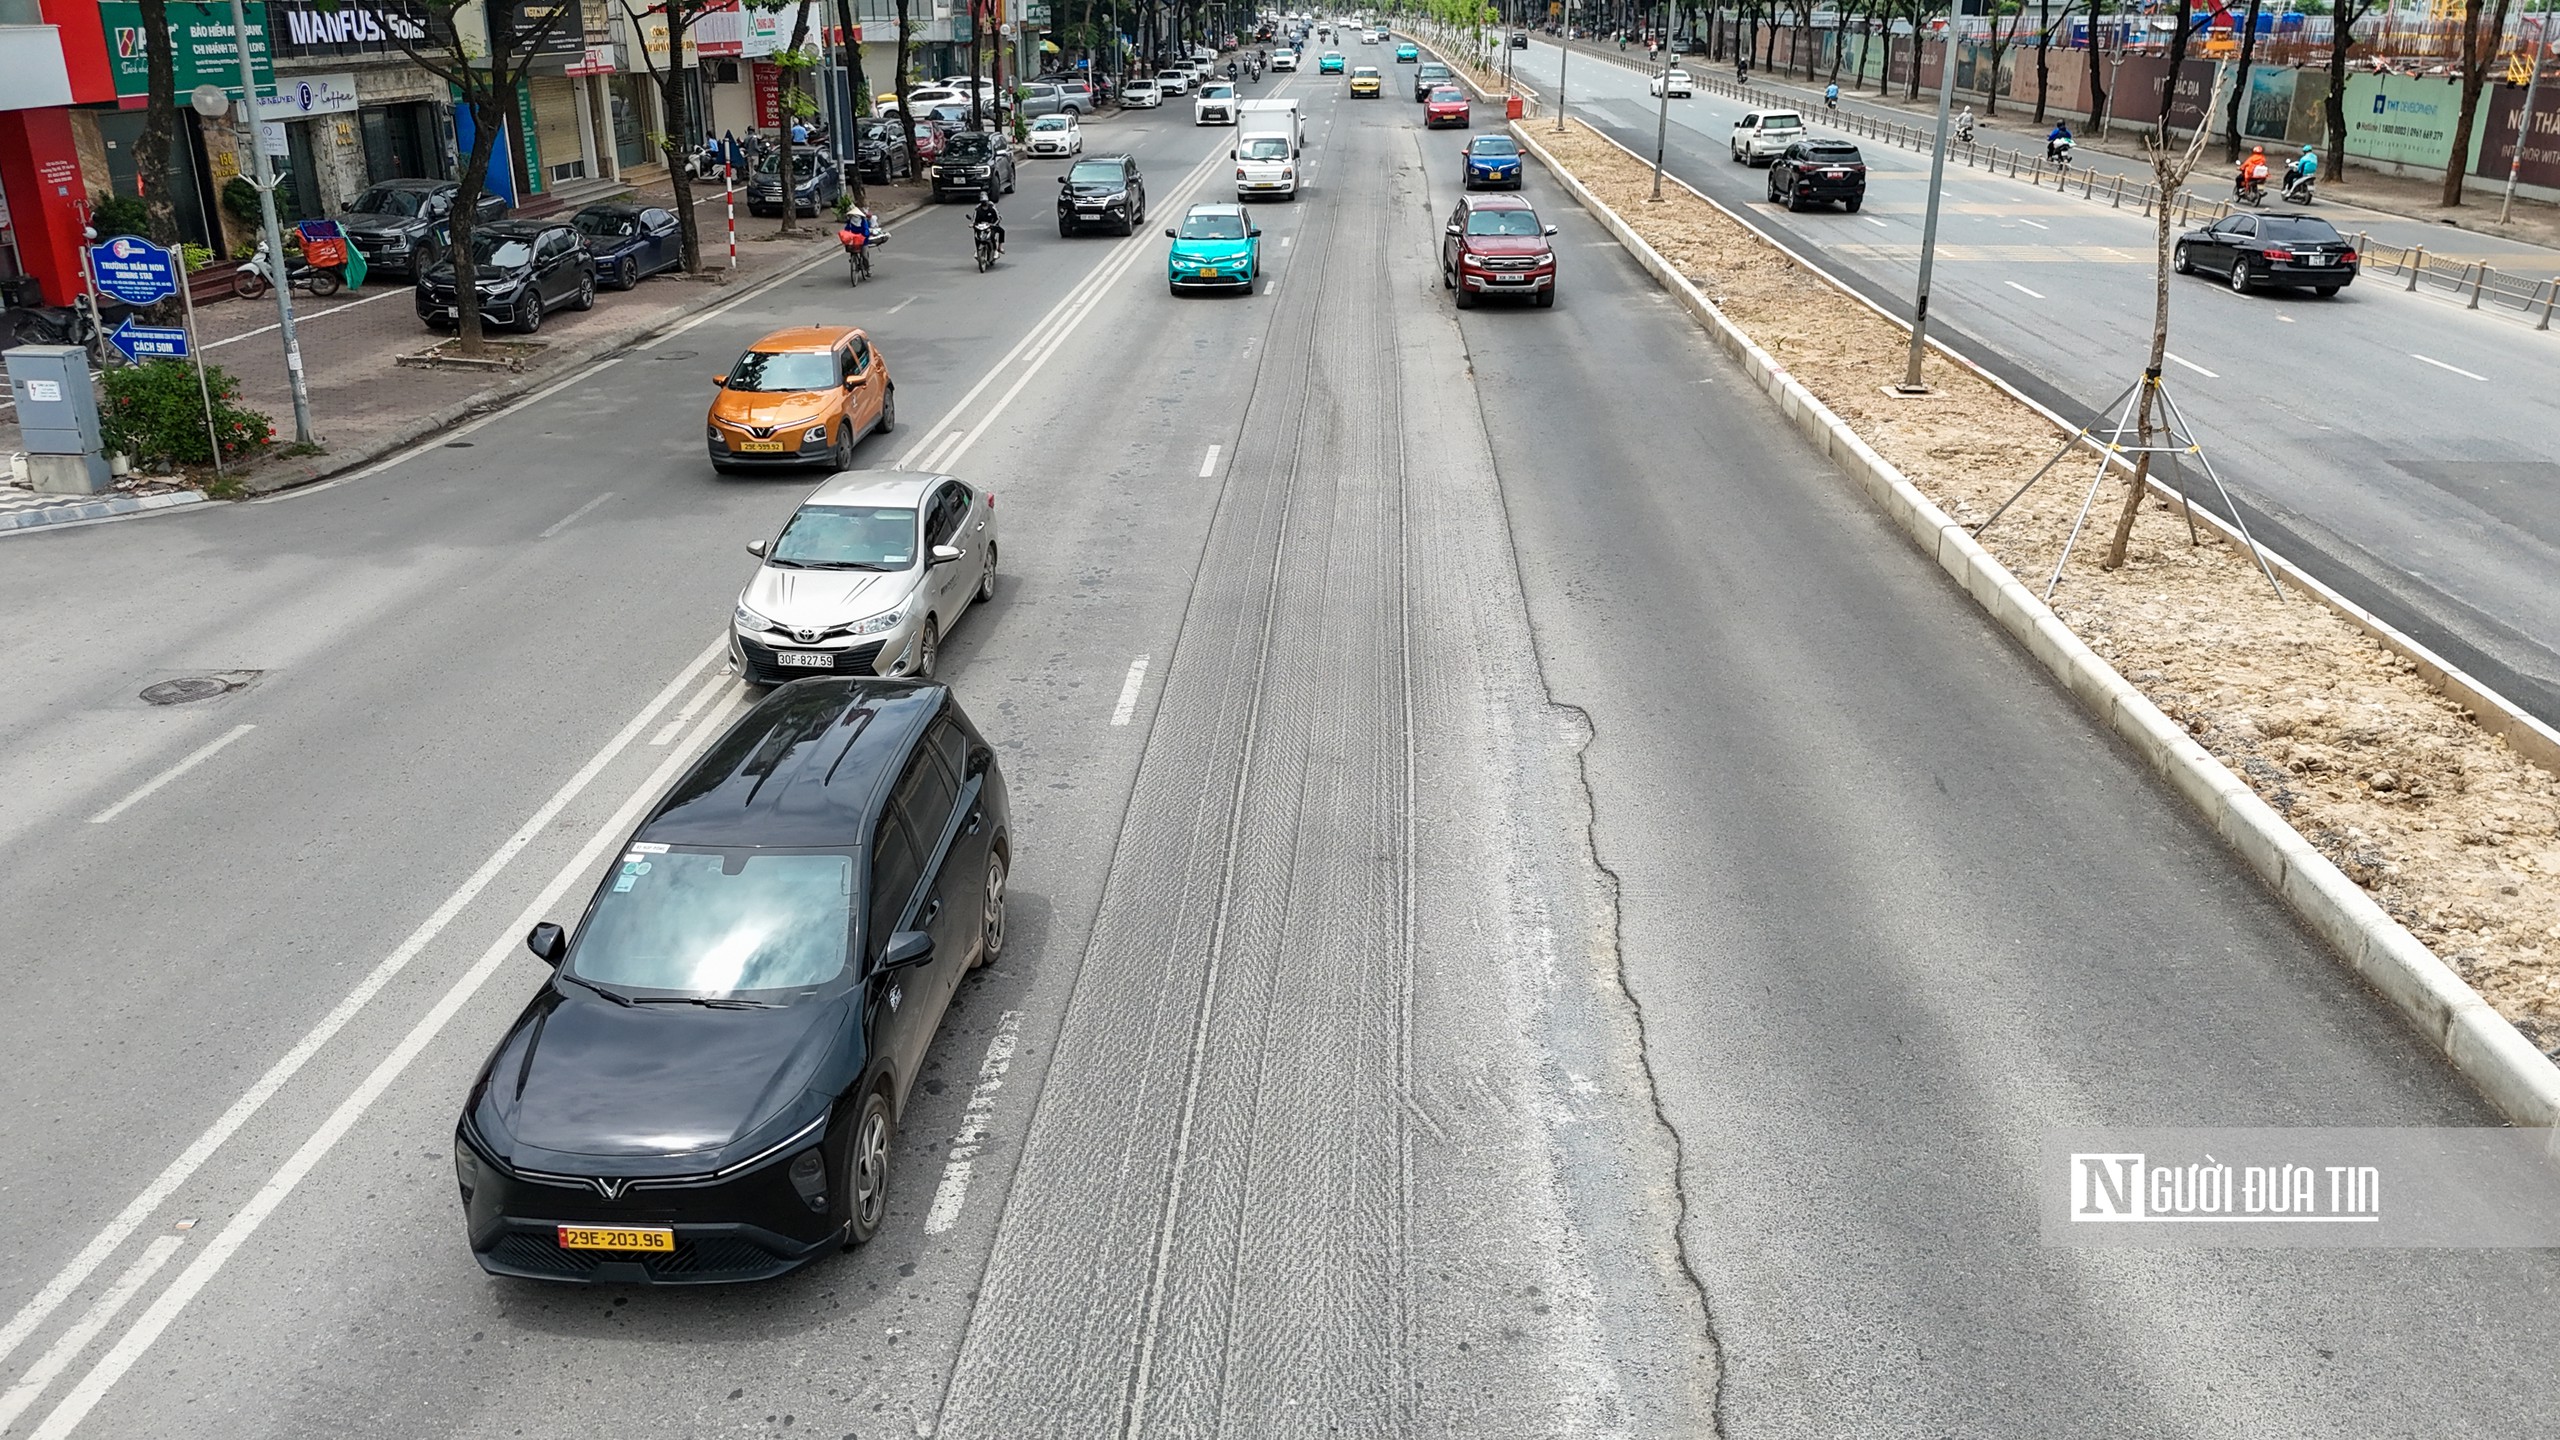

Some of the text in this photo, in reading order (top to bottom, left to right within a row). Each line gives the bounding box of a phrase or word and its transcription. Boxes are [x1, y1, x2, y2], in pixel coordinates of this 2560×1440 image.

[2501, 145, 2541, 161] INTRIOR
[133, 340, 174, 353] CÁCH 50M
[568, 1231, 665, 1248] 29E-203.96
